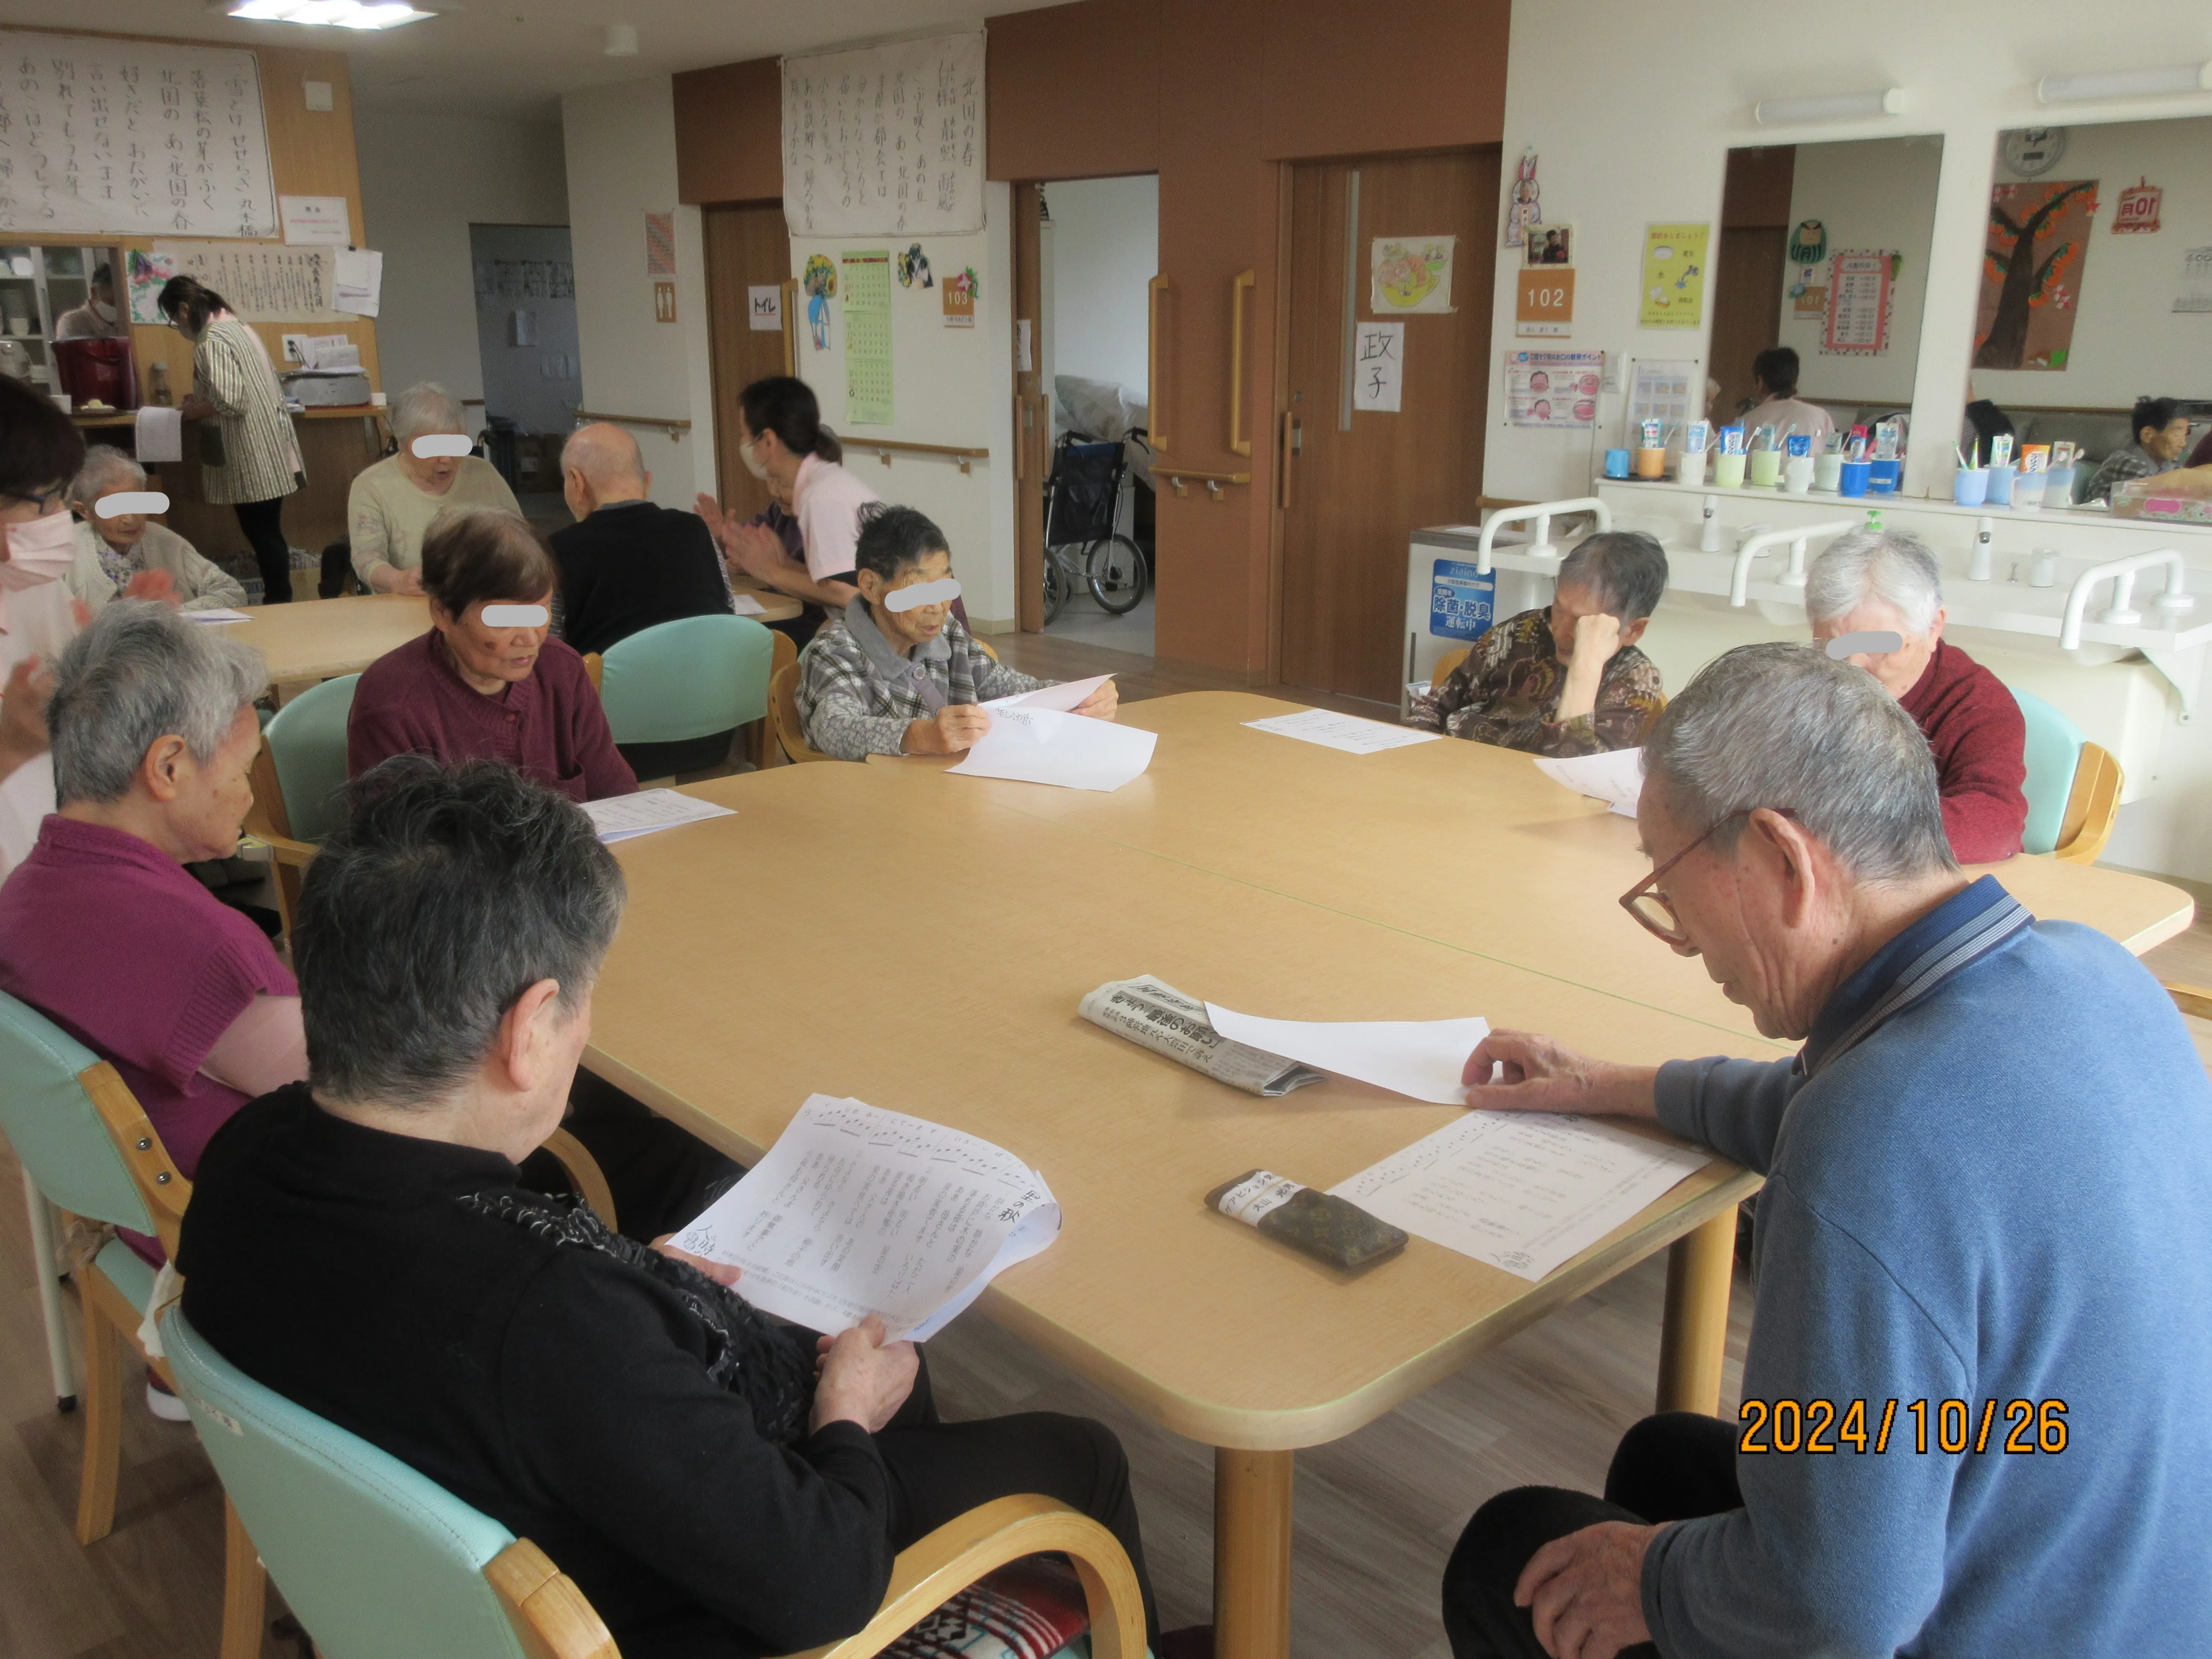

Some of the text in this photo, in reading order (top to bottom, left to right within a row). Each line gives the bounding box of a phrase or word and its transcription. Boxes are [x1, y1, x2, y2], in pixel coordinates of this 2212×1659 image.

[962, 76, 978, 166] 北国の春
[948, 291, 968, 305] 103
[1528, 288, 1564, 307] 102
[1360, 331, 1395, 399] 政子
[1432, 595, 1491, 621] 除菌・脱臭
[1445, 615, 1476, 631] 運転中
[997, 1190, 1041, 1224] 里の秋
[1253, 1198, 1272, 1212] 大山
